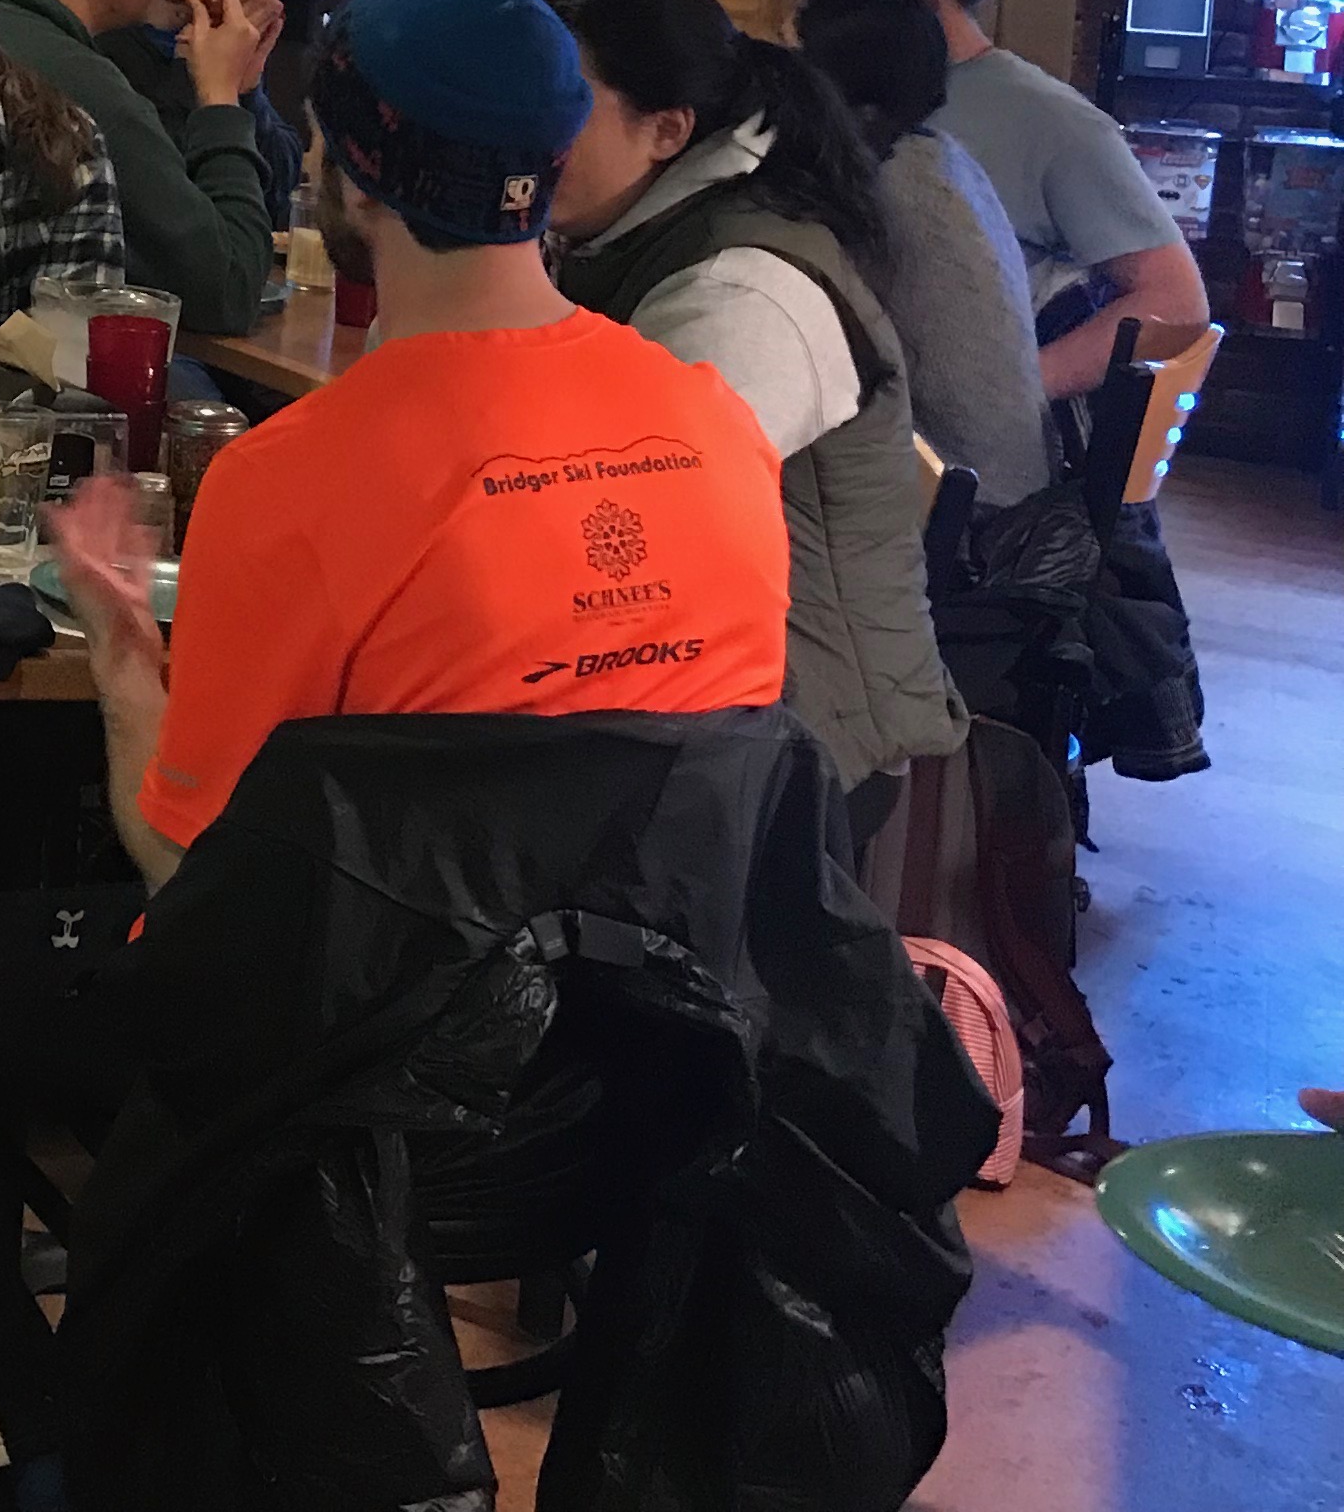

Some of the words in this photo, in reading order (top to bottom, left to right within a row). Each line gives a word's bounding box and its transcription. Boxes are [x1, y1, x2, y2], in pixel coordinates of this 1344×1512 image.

[482, 471, 559, 496] Bridger
[563, 463, 592, 483] Ski
[595, 454, 703, 479] Foundation
[572, 579, 672, 613] SCHNEE'S
[575, 639, 705, 677] BROOKS
